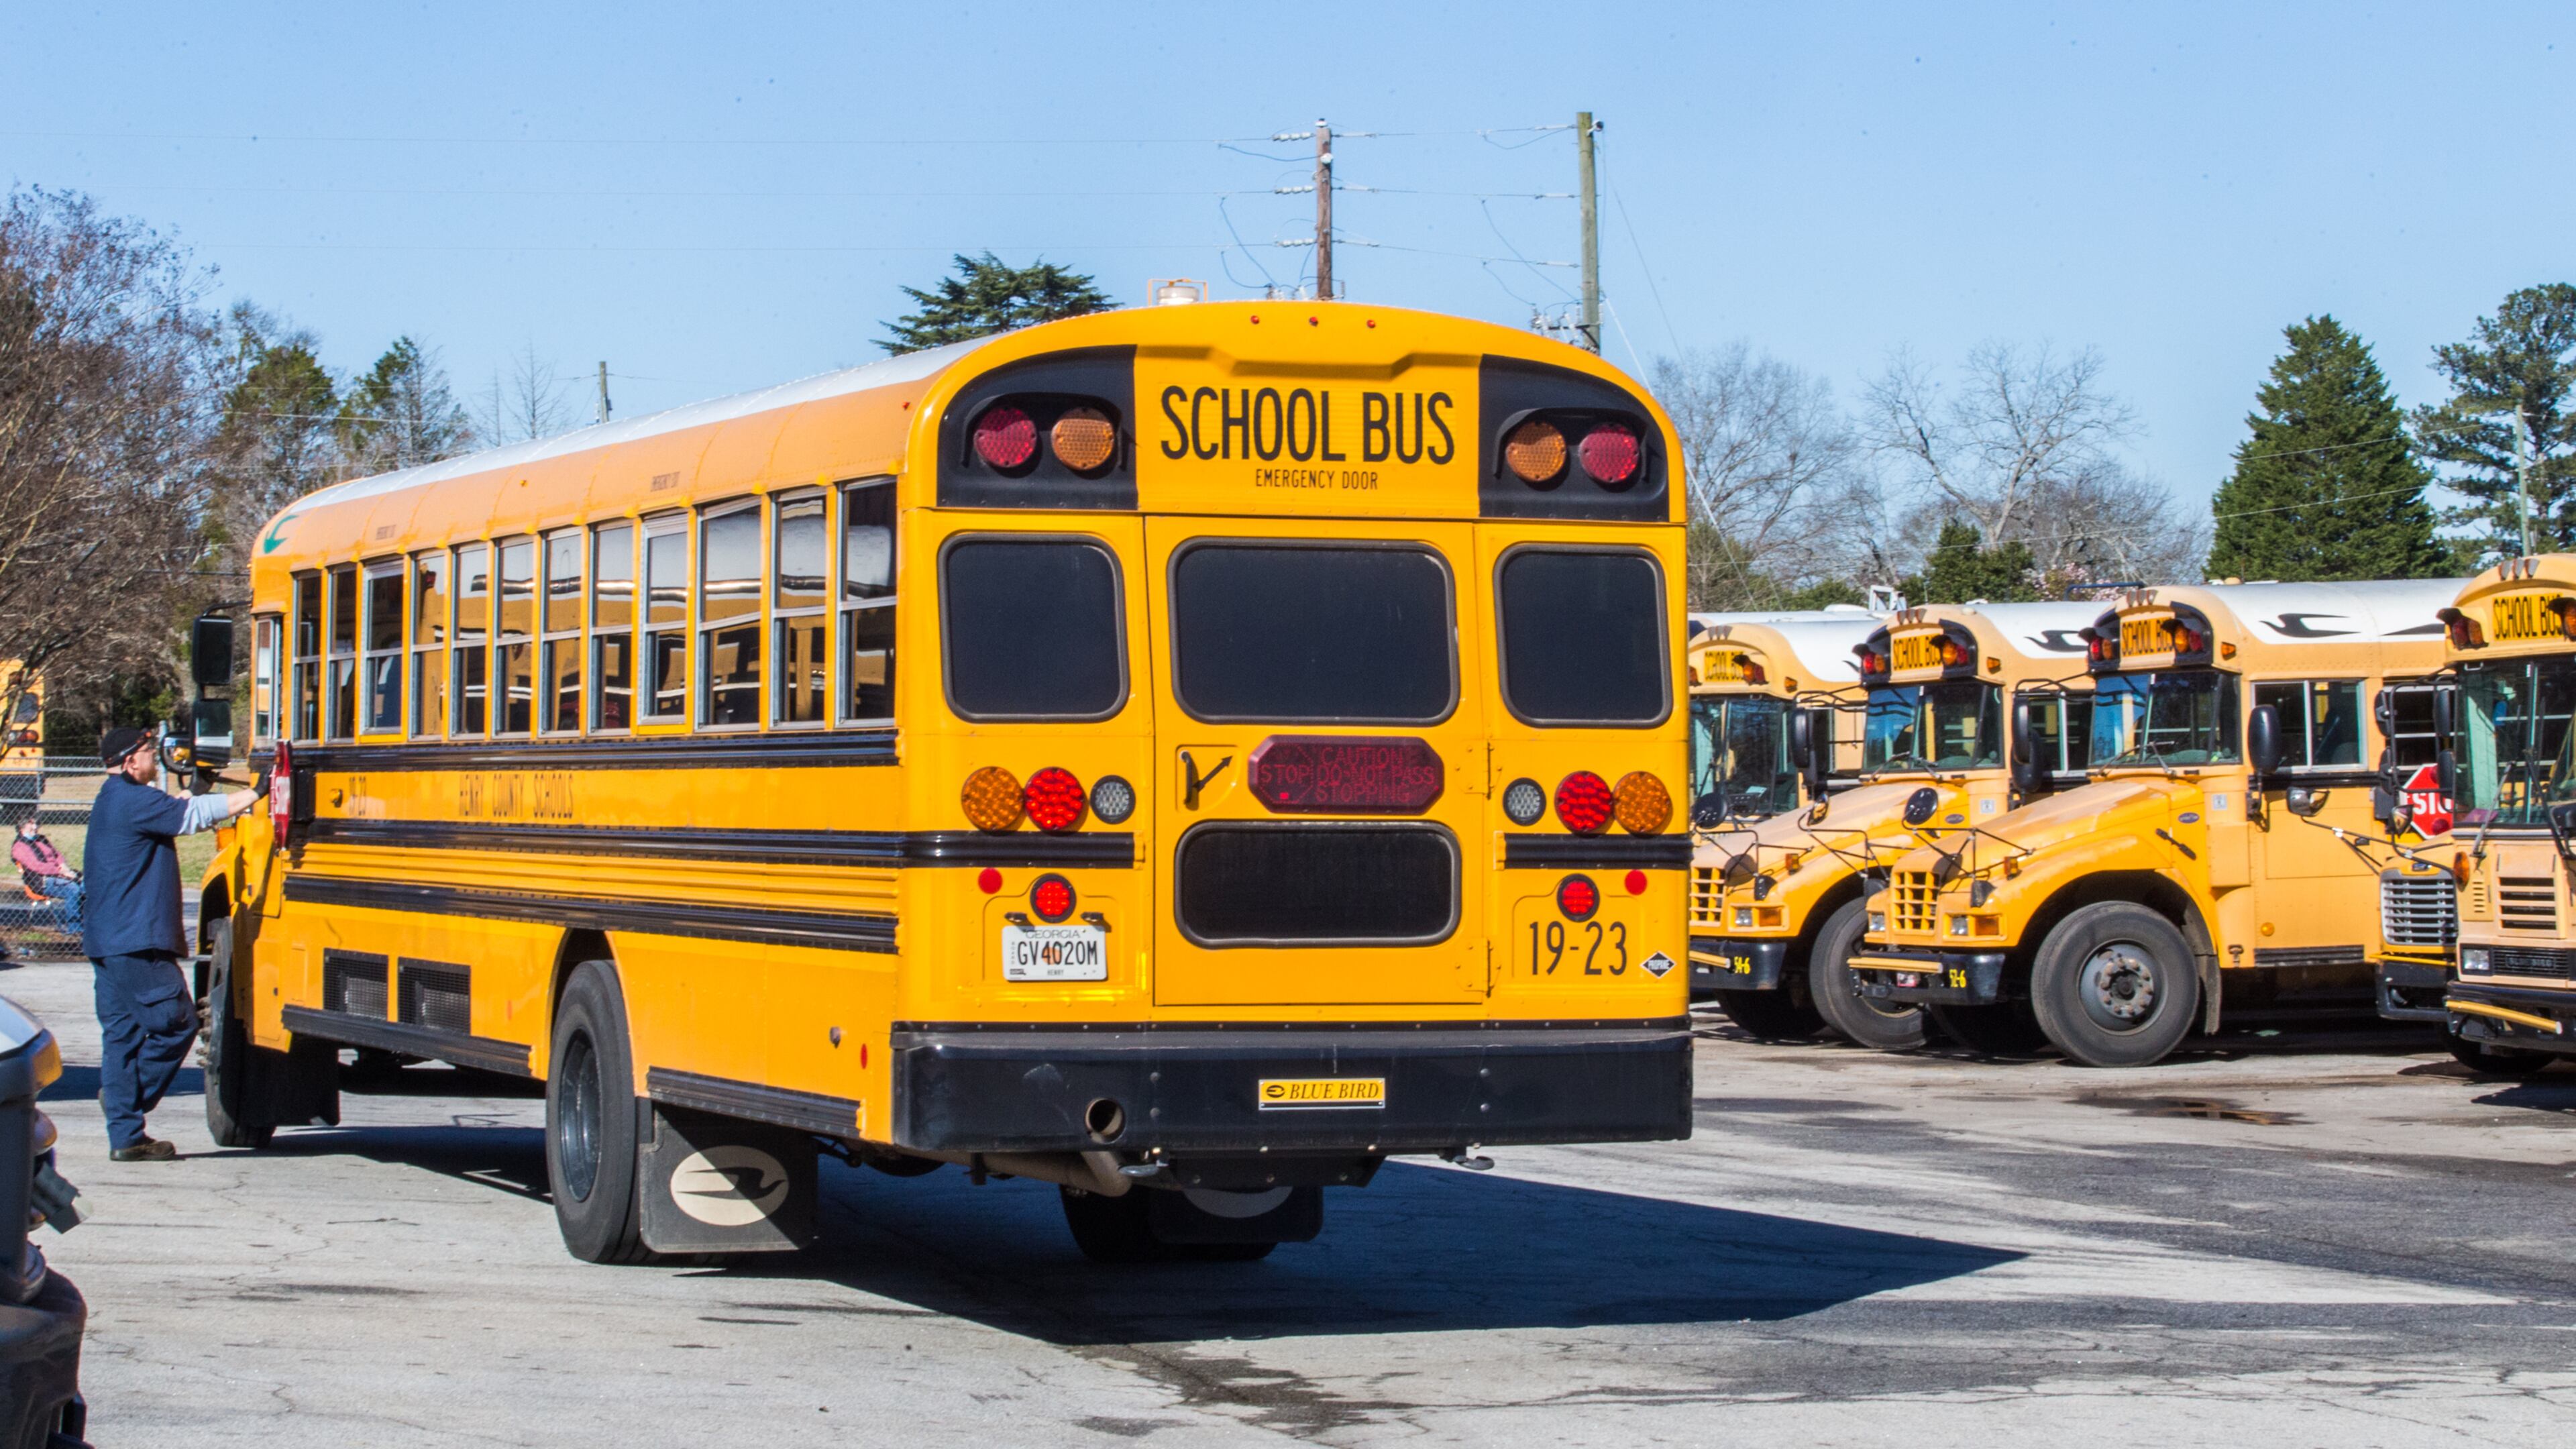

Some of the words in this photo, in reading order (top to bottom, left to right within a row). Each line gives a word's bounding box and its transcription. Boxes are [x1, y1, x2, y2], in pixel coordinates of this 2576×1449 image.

[1161, 385, 1346, 463] SCHOOL
[1362, 391, 1454, 465] BUS
[1256, 468, 1335, 489] EMERGENCY
[1342, 471, 1379, 490] DOOR
[2493, 597, 2538, 639] SCHOOL
[2122, 620, 2154, 656] SCHOOL
[1893, 635, 1923, 670] SCHOOL
[1321, 747, 1403, 765] CAUTION
[1259, 764, 1310, 785] STOP
[1317, 765, 1342, 785] DO
[1350, 765, 1386, 786] NOT
[1391, 765, 1437, 786] PASS
[1316, 784, 1411, 803] STOPPING
[2412, 790, 2453, 815] STO
[1026, 930, 1081, 939] GEORGIA
[1018, 941, 1098, 965] GV4020M
[1529, 920, 1627, 975] 19-23
[1289, 1083, 1334, 1099] BLUE
[1338, 1083, 1379, 1098] BIRD
